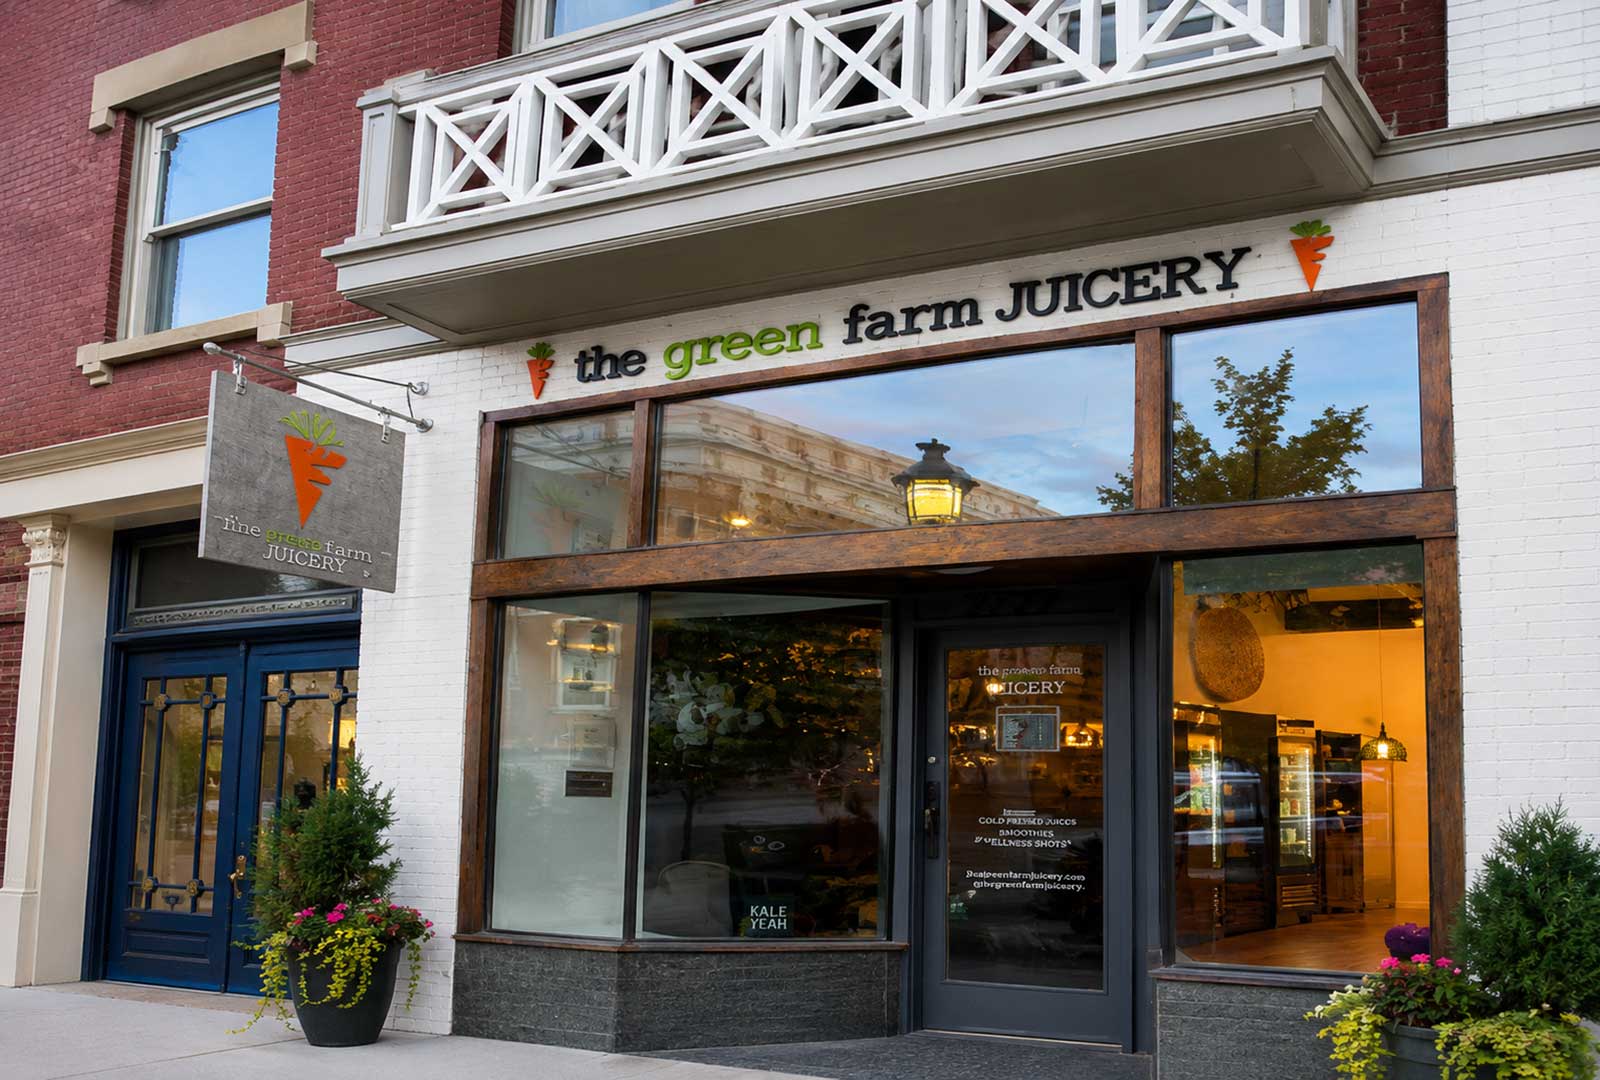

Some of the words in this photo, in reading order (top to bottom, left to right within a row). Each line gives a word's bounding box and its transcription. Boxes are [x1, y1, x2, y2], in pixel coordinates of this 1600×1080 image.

[574, 345, 647, 383] the
[663, 321, 823, 380] green
[842, 303, 983, 345] farm
[995, 246, 1252, 322] JUICERY
[262, 544, 348, 573] JUICERY
[325, 540, 373, 563] farm
[978, 816, 1005, 825] COLD
[750, 905, 787, 917] KALE
[750, 918, 787, 930] YEAH
